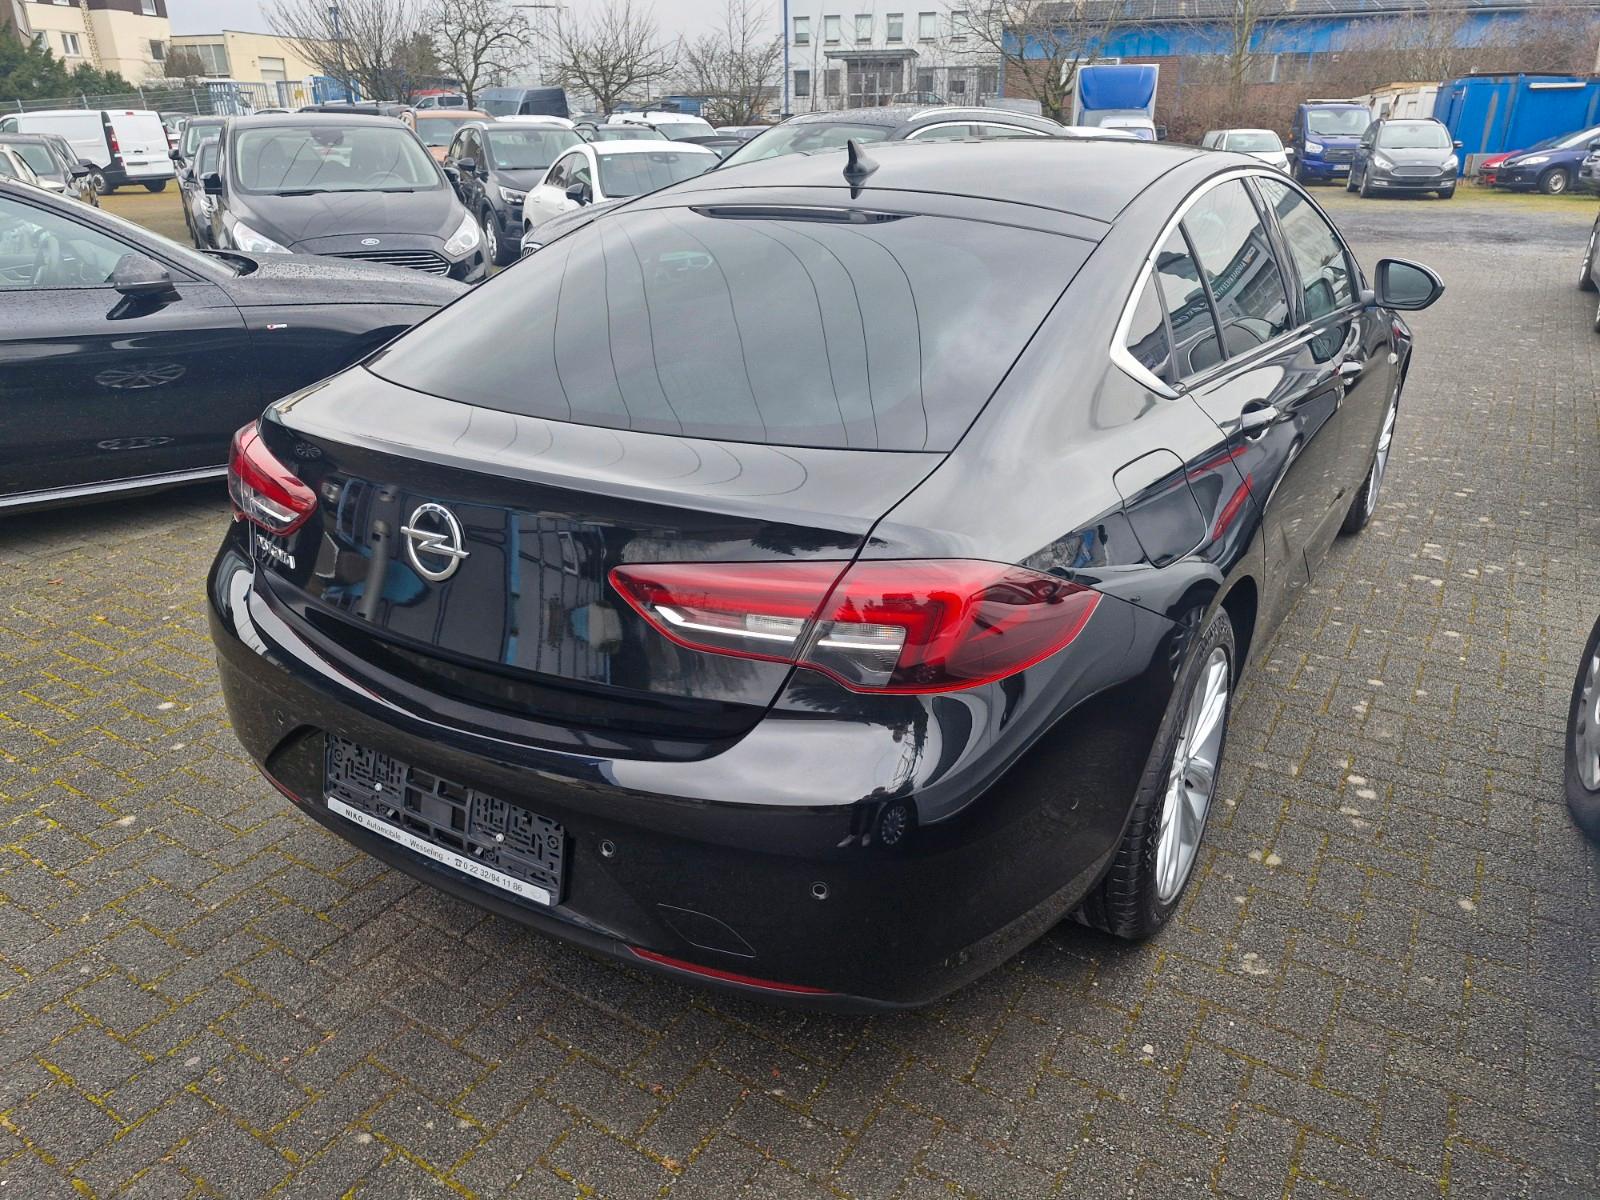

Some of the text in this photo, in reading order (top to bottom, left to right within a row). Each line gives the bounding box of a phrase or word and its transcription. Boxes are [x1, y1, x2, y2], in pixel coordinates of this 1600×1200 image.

[346, 808, 363, 823] NIKO
[366, 819, 402, 841] Automobile
[410, 838, 444, 861] Wesseling
[502, 878, 511, 889] 11
